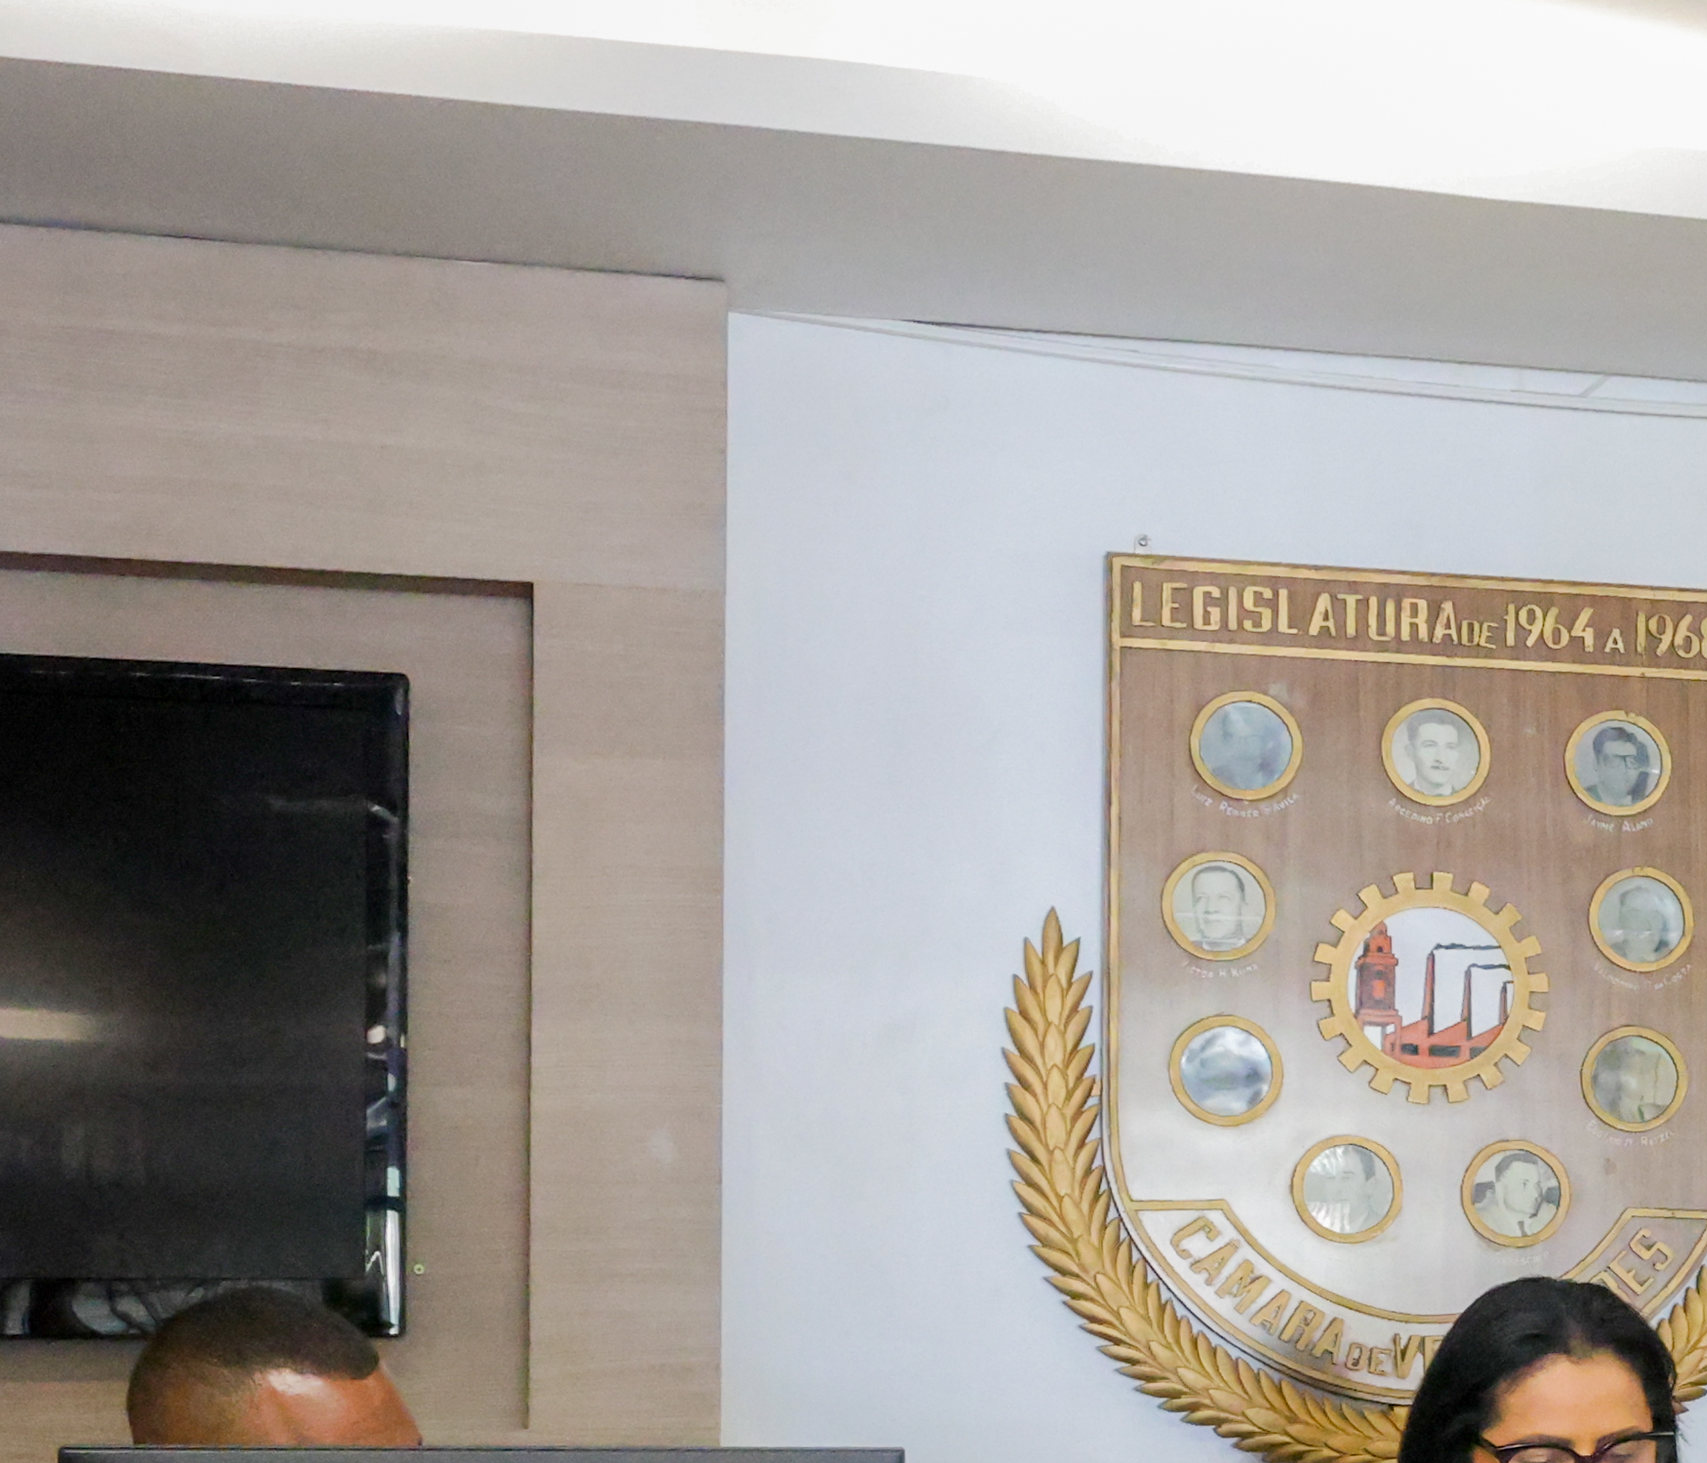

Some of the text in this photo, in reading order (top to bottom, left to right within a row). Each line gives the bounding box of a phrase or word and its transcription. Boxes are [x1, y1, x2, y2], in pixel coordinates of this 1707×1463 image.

[1131, 580, 1459, 646] LEGISLATURA
[1461, 620, 1499, 650] DE
[1504, 602, 1595, 653] 1964
[1604, 627, 1626, 654] A
[1345, 1342, 1391, 1376] DE
